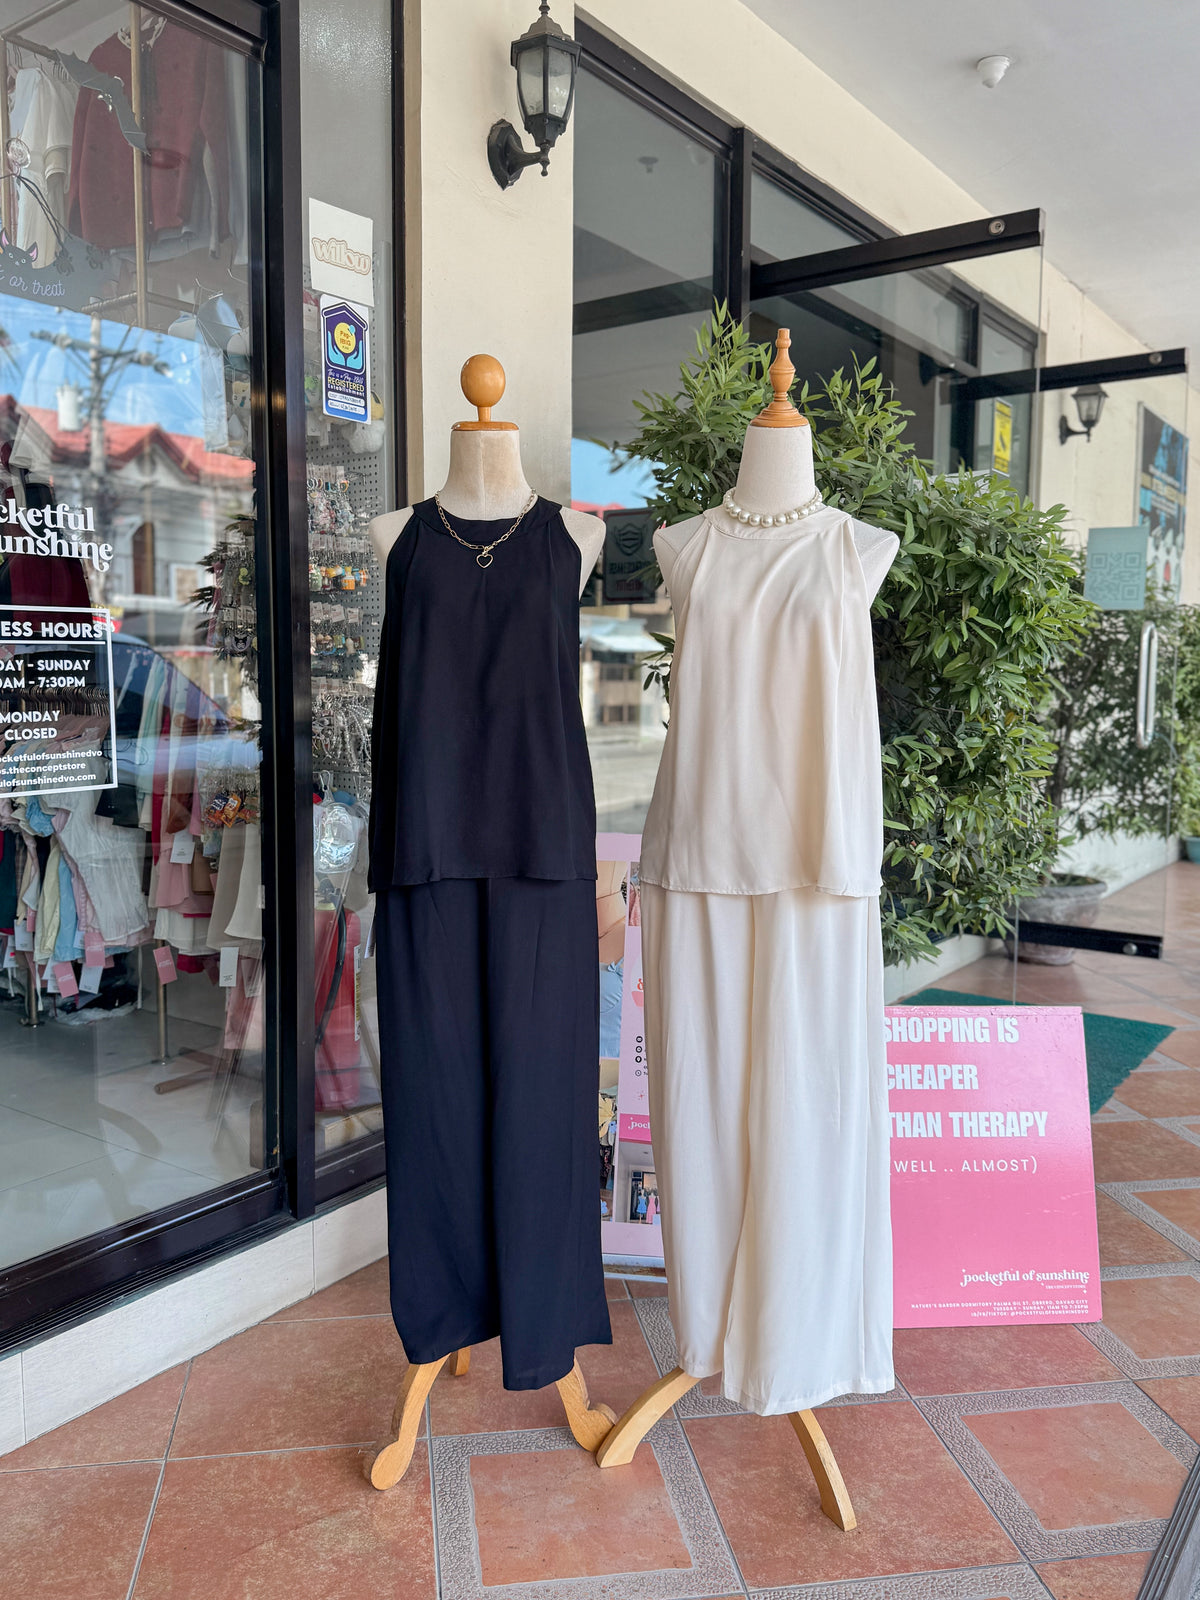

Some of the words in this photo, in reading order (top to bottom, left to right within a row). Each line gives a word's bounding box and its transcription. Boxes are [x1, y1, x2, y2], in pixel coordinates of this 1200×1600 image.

[9, 275, 28, 292] or
[32, 279, 66, 297] treat
[328, 376, 365, 392] REGISTERED
[41, 622, 103, 638] HOURS
[37, 659, 91, 671] SUNDAY
[0, 676, 25, 689] AM
[38, 676, 86, 688] 7:30PM
[0, 710, 60, 724] MONDAY
[4, 727, 58, 741] CLOSED
[0, 750, 103, 763] cketfulofsunshinedvo
[884, 1016, 990, 1043] SHOPPING
[997, 1017, 1020, 1043] IS
[887, 1064, 979, 1090] CHEAPER
[949, 1111, 1049, 1138] THERAPY
[890, 1160, 937, 1174] WELL
[961, 1156, 1038, 1174] ALMOST)
[960, 1270, 1020, 1287] pocketful
[1022, 1269, 1036, 1281] of
[1036, 1269, 1090, 1284] sunshine
